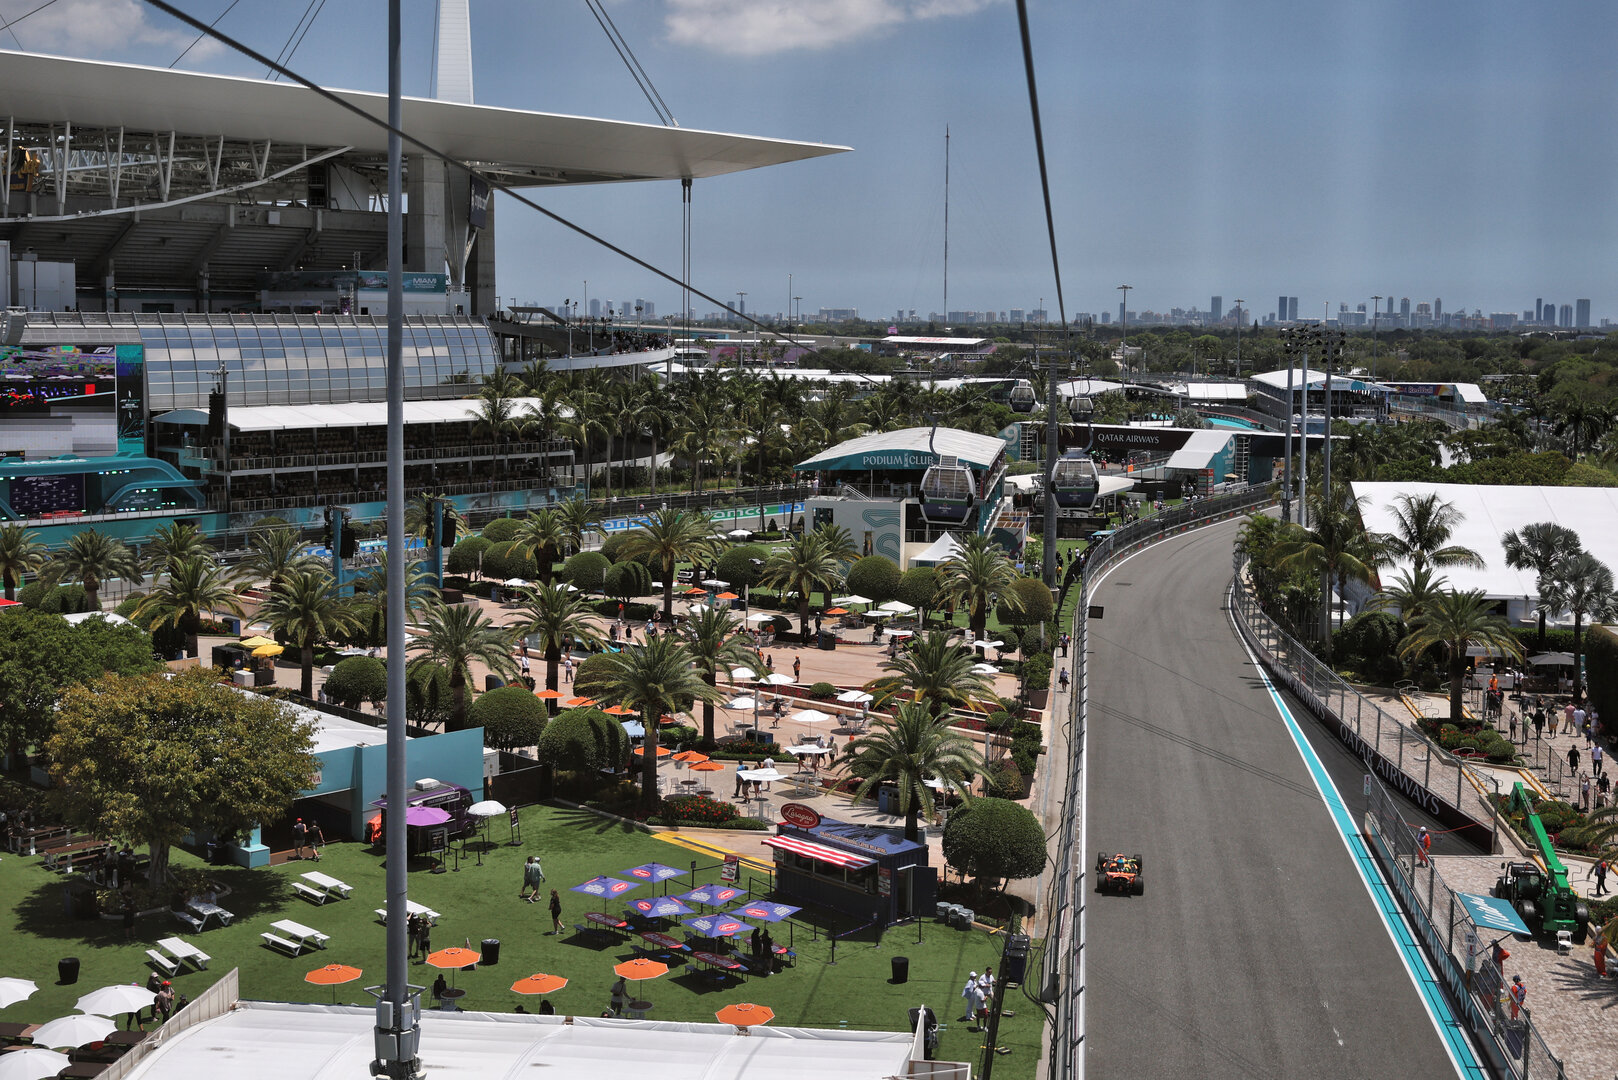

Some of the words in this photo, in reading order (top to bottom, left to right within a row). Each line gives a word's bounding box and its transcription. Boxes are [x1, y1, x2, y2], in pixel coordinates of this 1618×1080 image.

[1098, 433, 1124, 443] QATAR
[1126, 435, 1160, 444] AIRWAYS
[1227, 436, 1236, 459] 9
[862, 456, 903, 466] PODIUM
[909, 455, 935, 465] CLUB
[1340, 724, 1374, 766] QATAR
[1376, 758, 1440, 815] AIRWAYS
[785, 807, 815, 823] Lasagna
[1392, 866, 1425, 933] QATAR
[1426, 929, 1478, 1034] AIRWAYS
